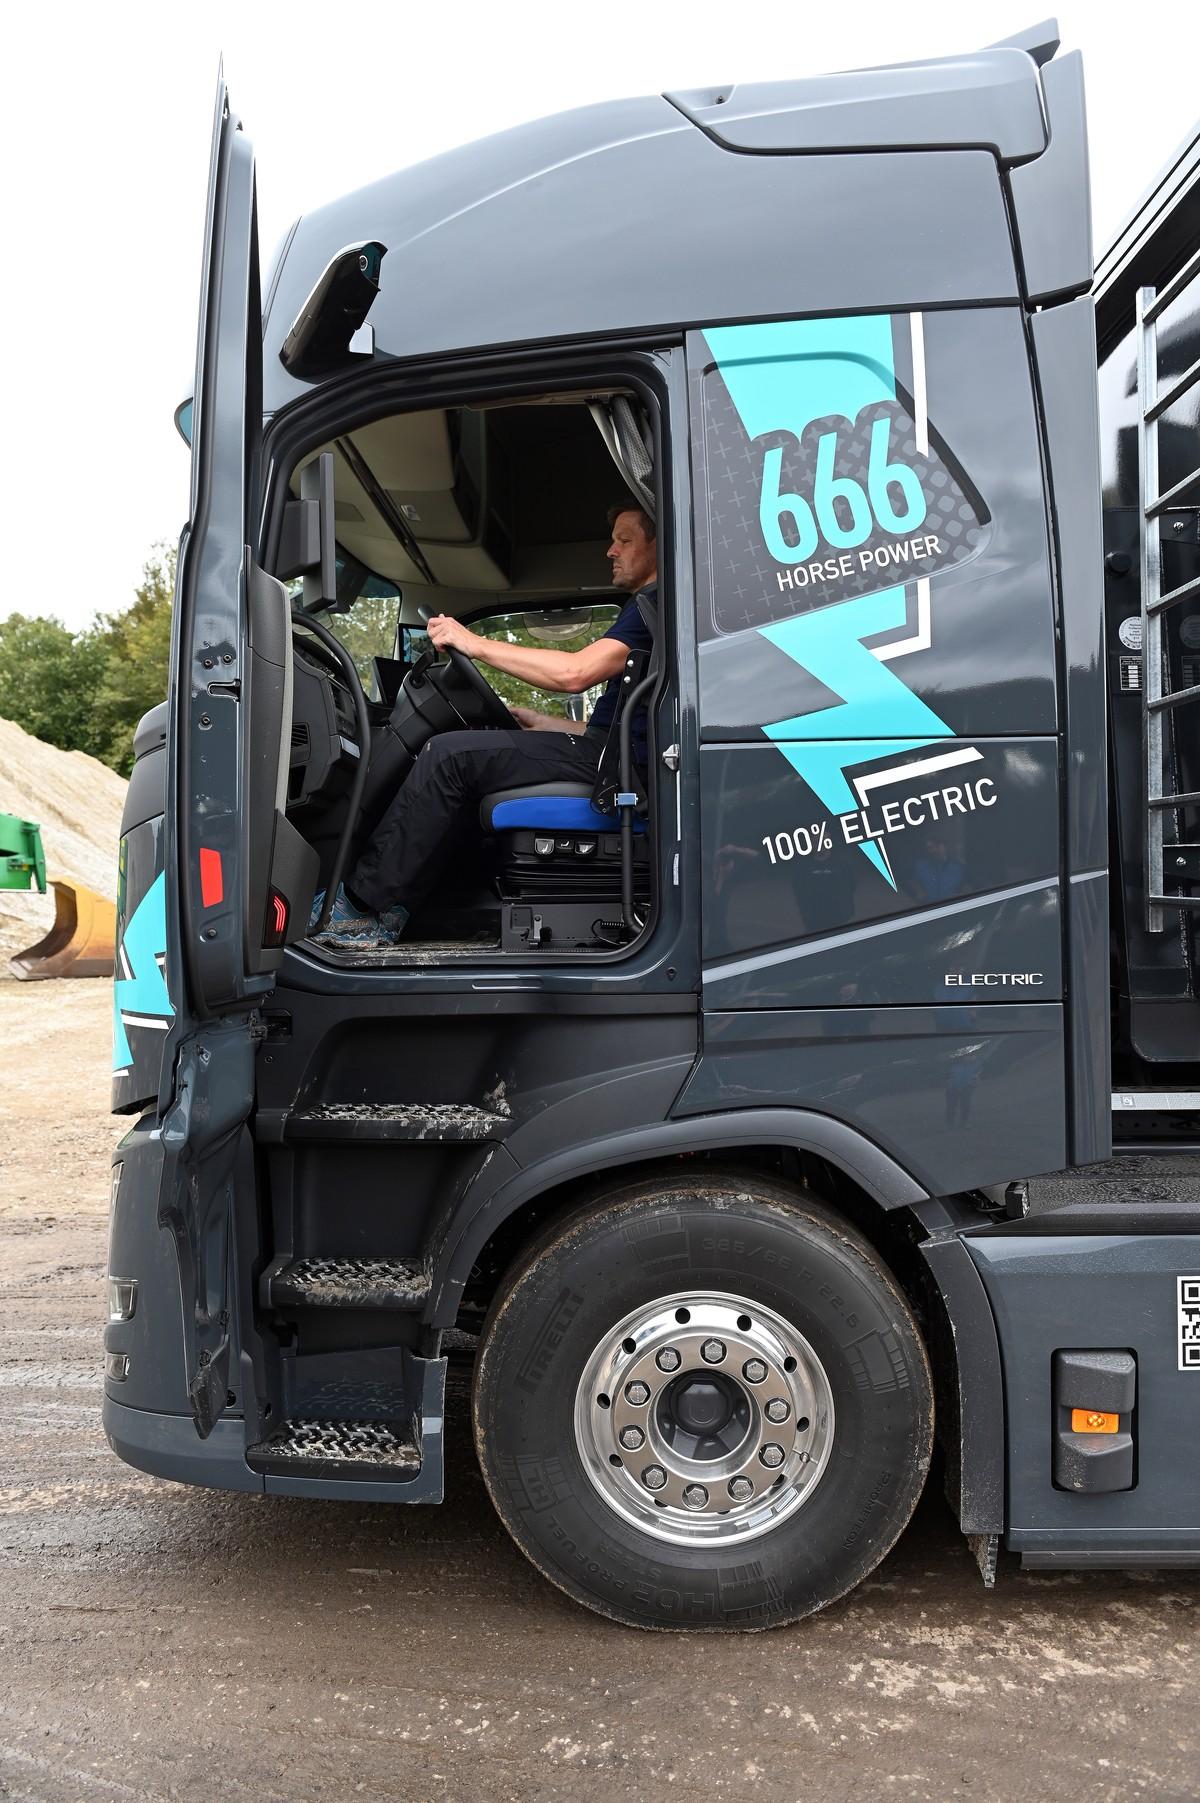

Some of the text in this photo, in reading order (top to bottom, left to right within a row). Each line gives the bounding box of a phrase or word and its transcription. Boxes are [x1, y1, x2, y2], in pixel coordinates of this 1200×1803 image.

[759, 417, 927, 565] 666
[776, 534, 942, 592] HORSE POWER
[762, 777, 998, 864] 100% ELECTRIC
[944, 973, 1044, 986] ELECTRIC
[514, 1287, 585, 1395] PIRELLI
